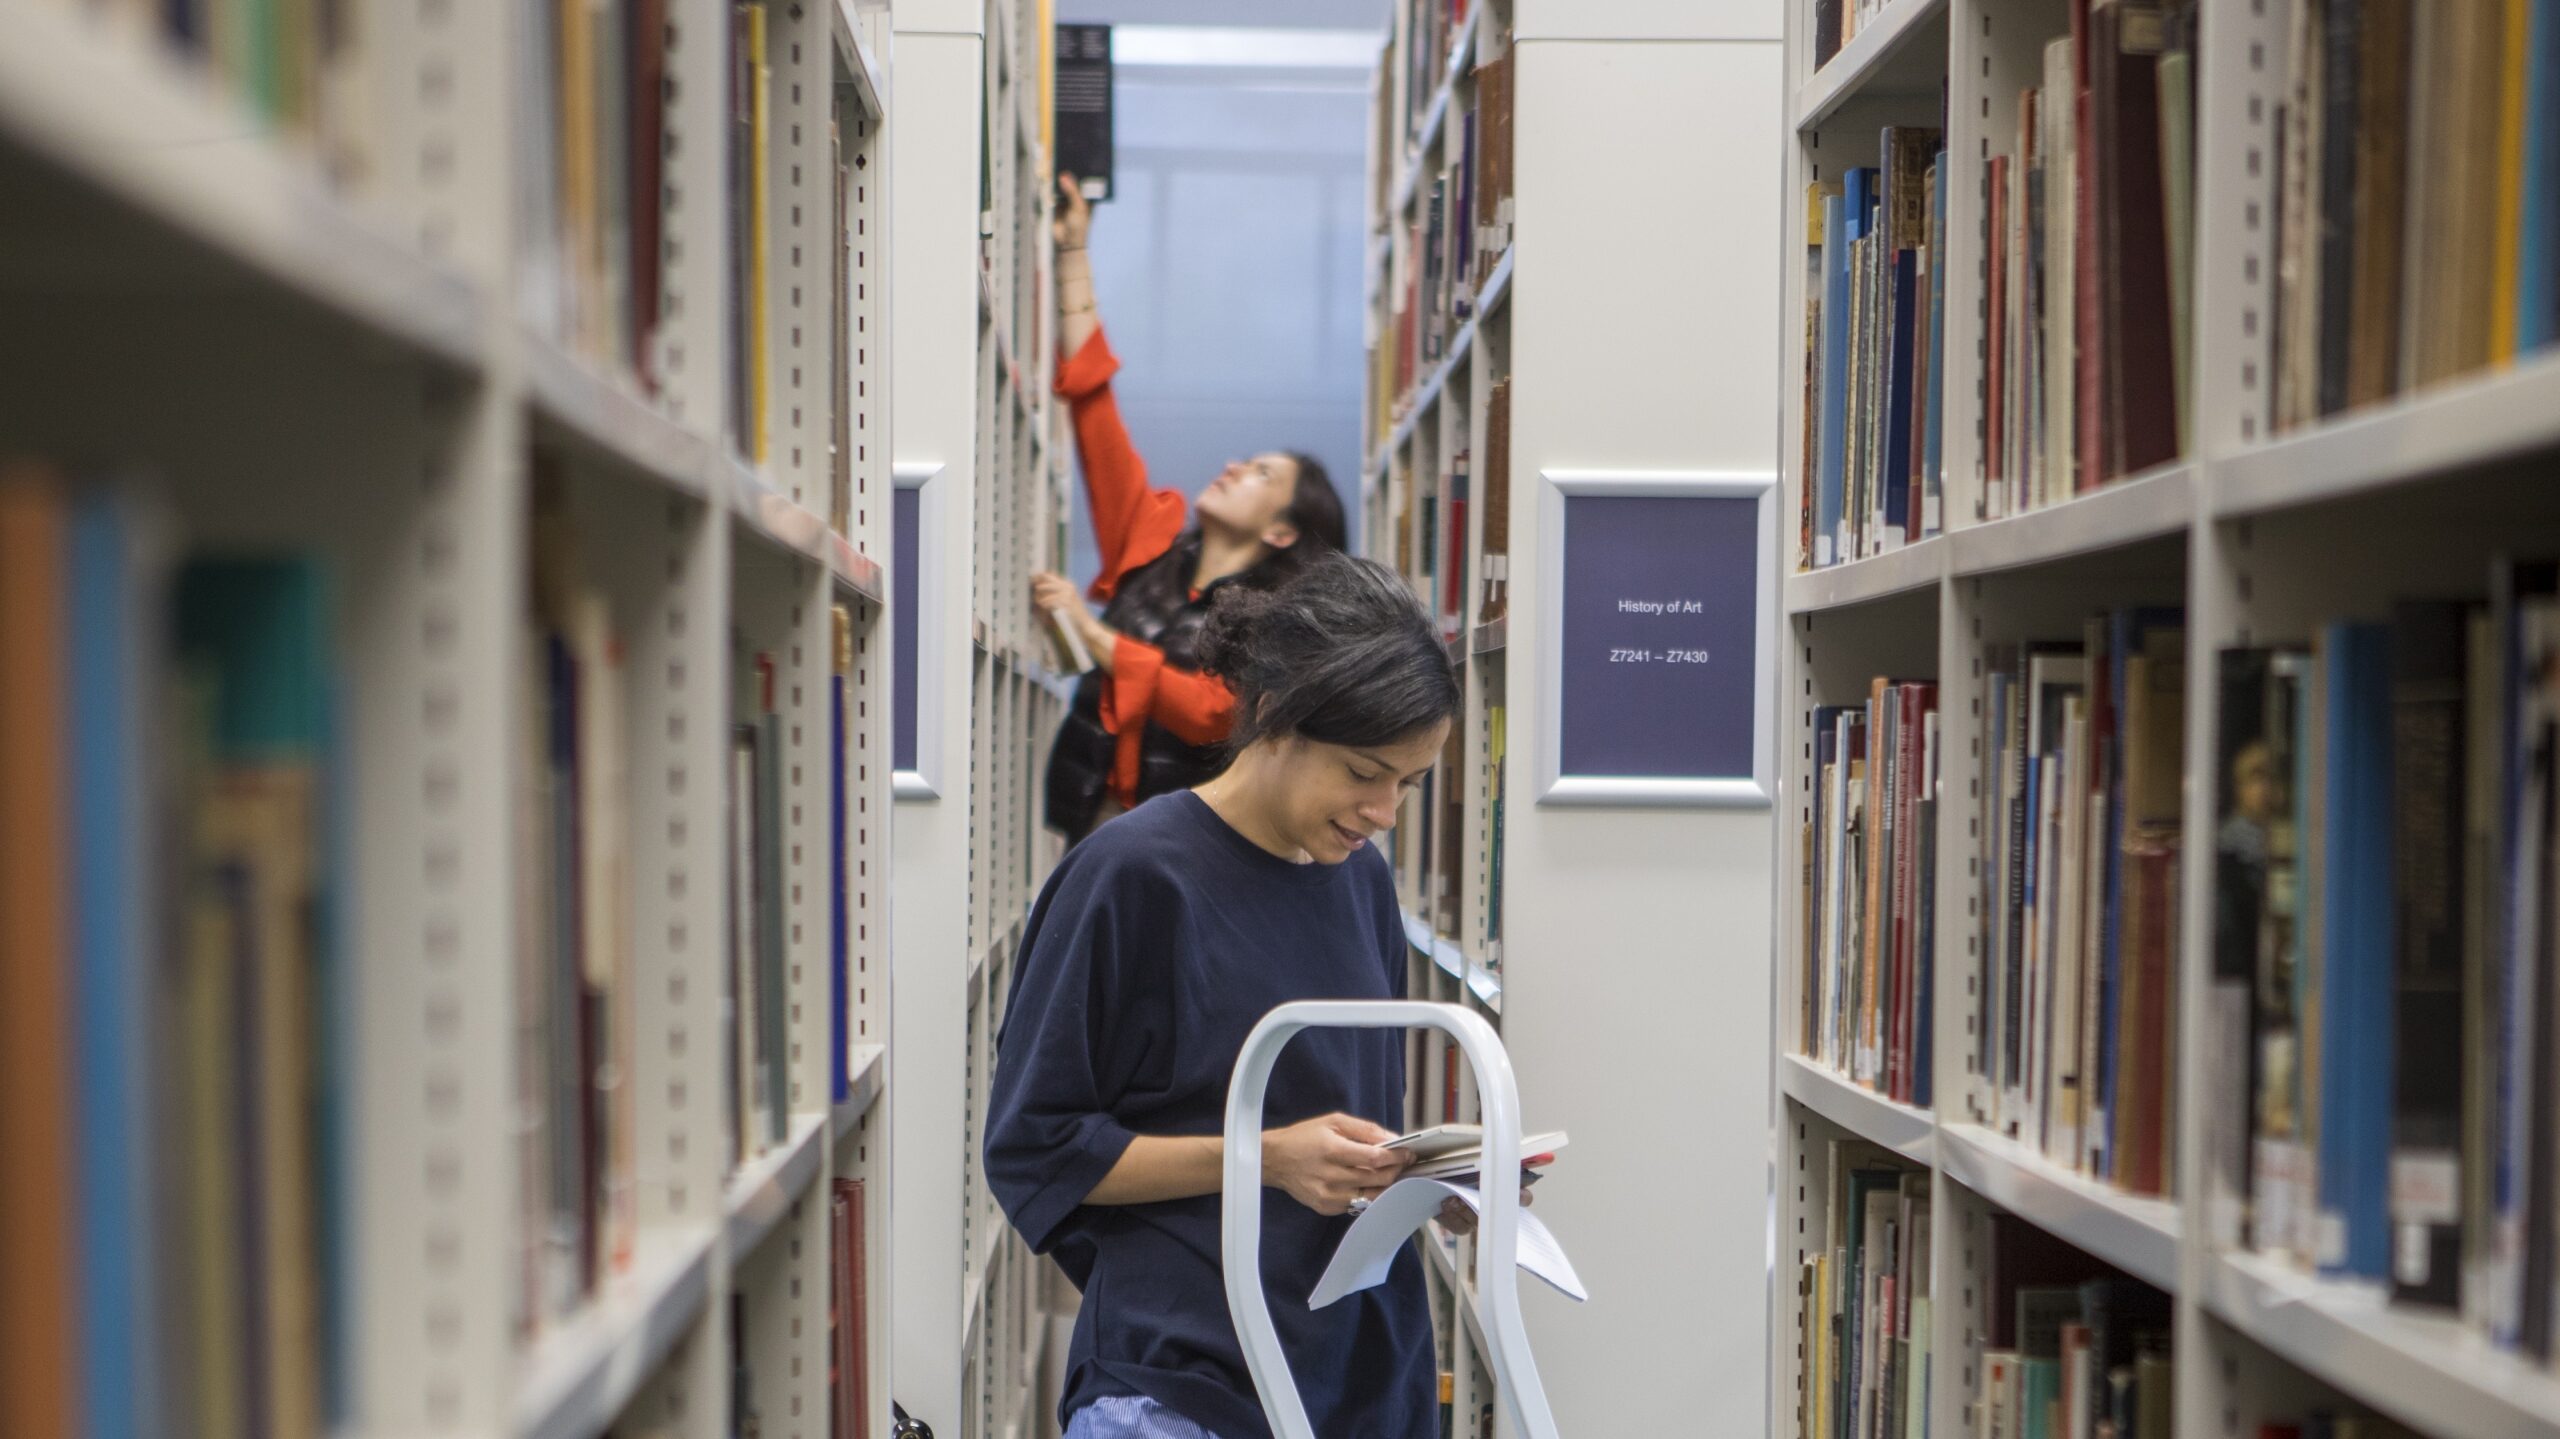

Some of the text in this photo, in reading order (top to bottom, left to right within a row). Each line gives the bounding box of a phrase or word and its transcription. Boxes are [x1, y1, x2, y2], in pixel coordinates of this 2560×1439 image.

[1618, 600, 1702, 616] History of Art
[1609, 649, 1650, 663] Z7241
[1666, 649, 1708, 664] Z7430
